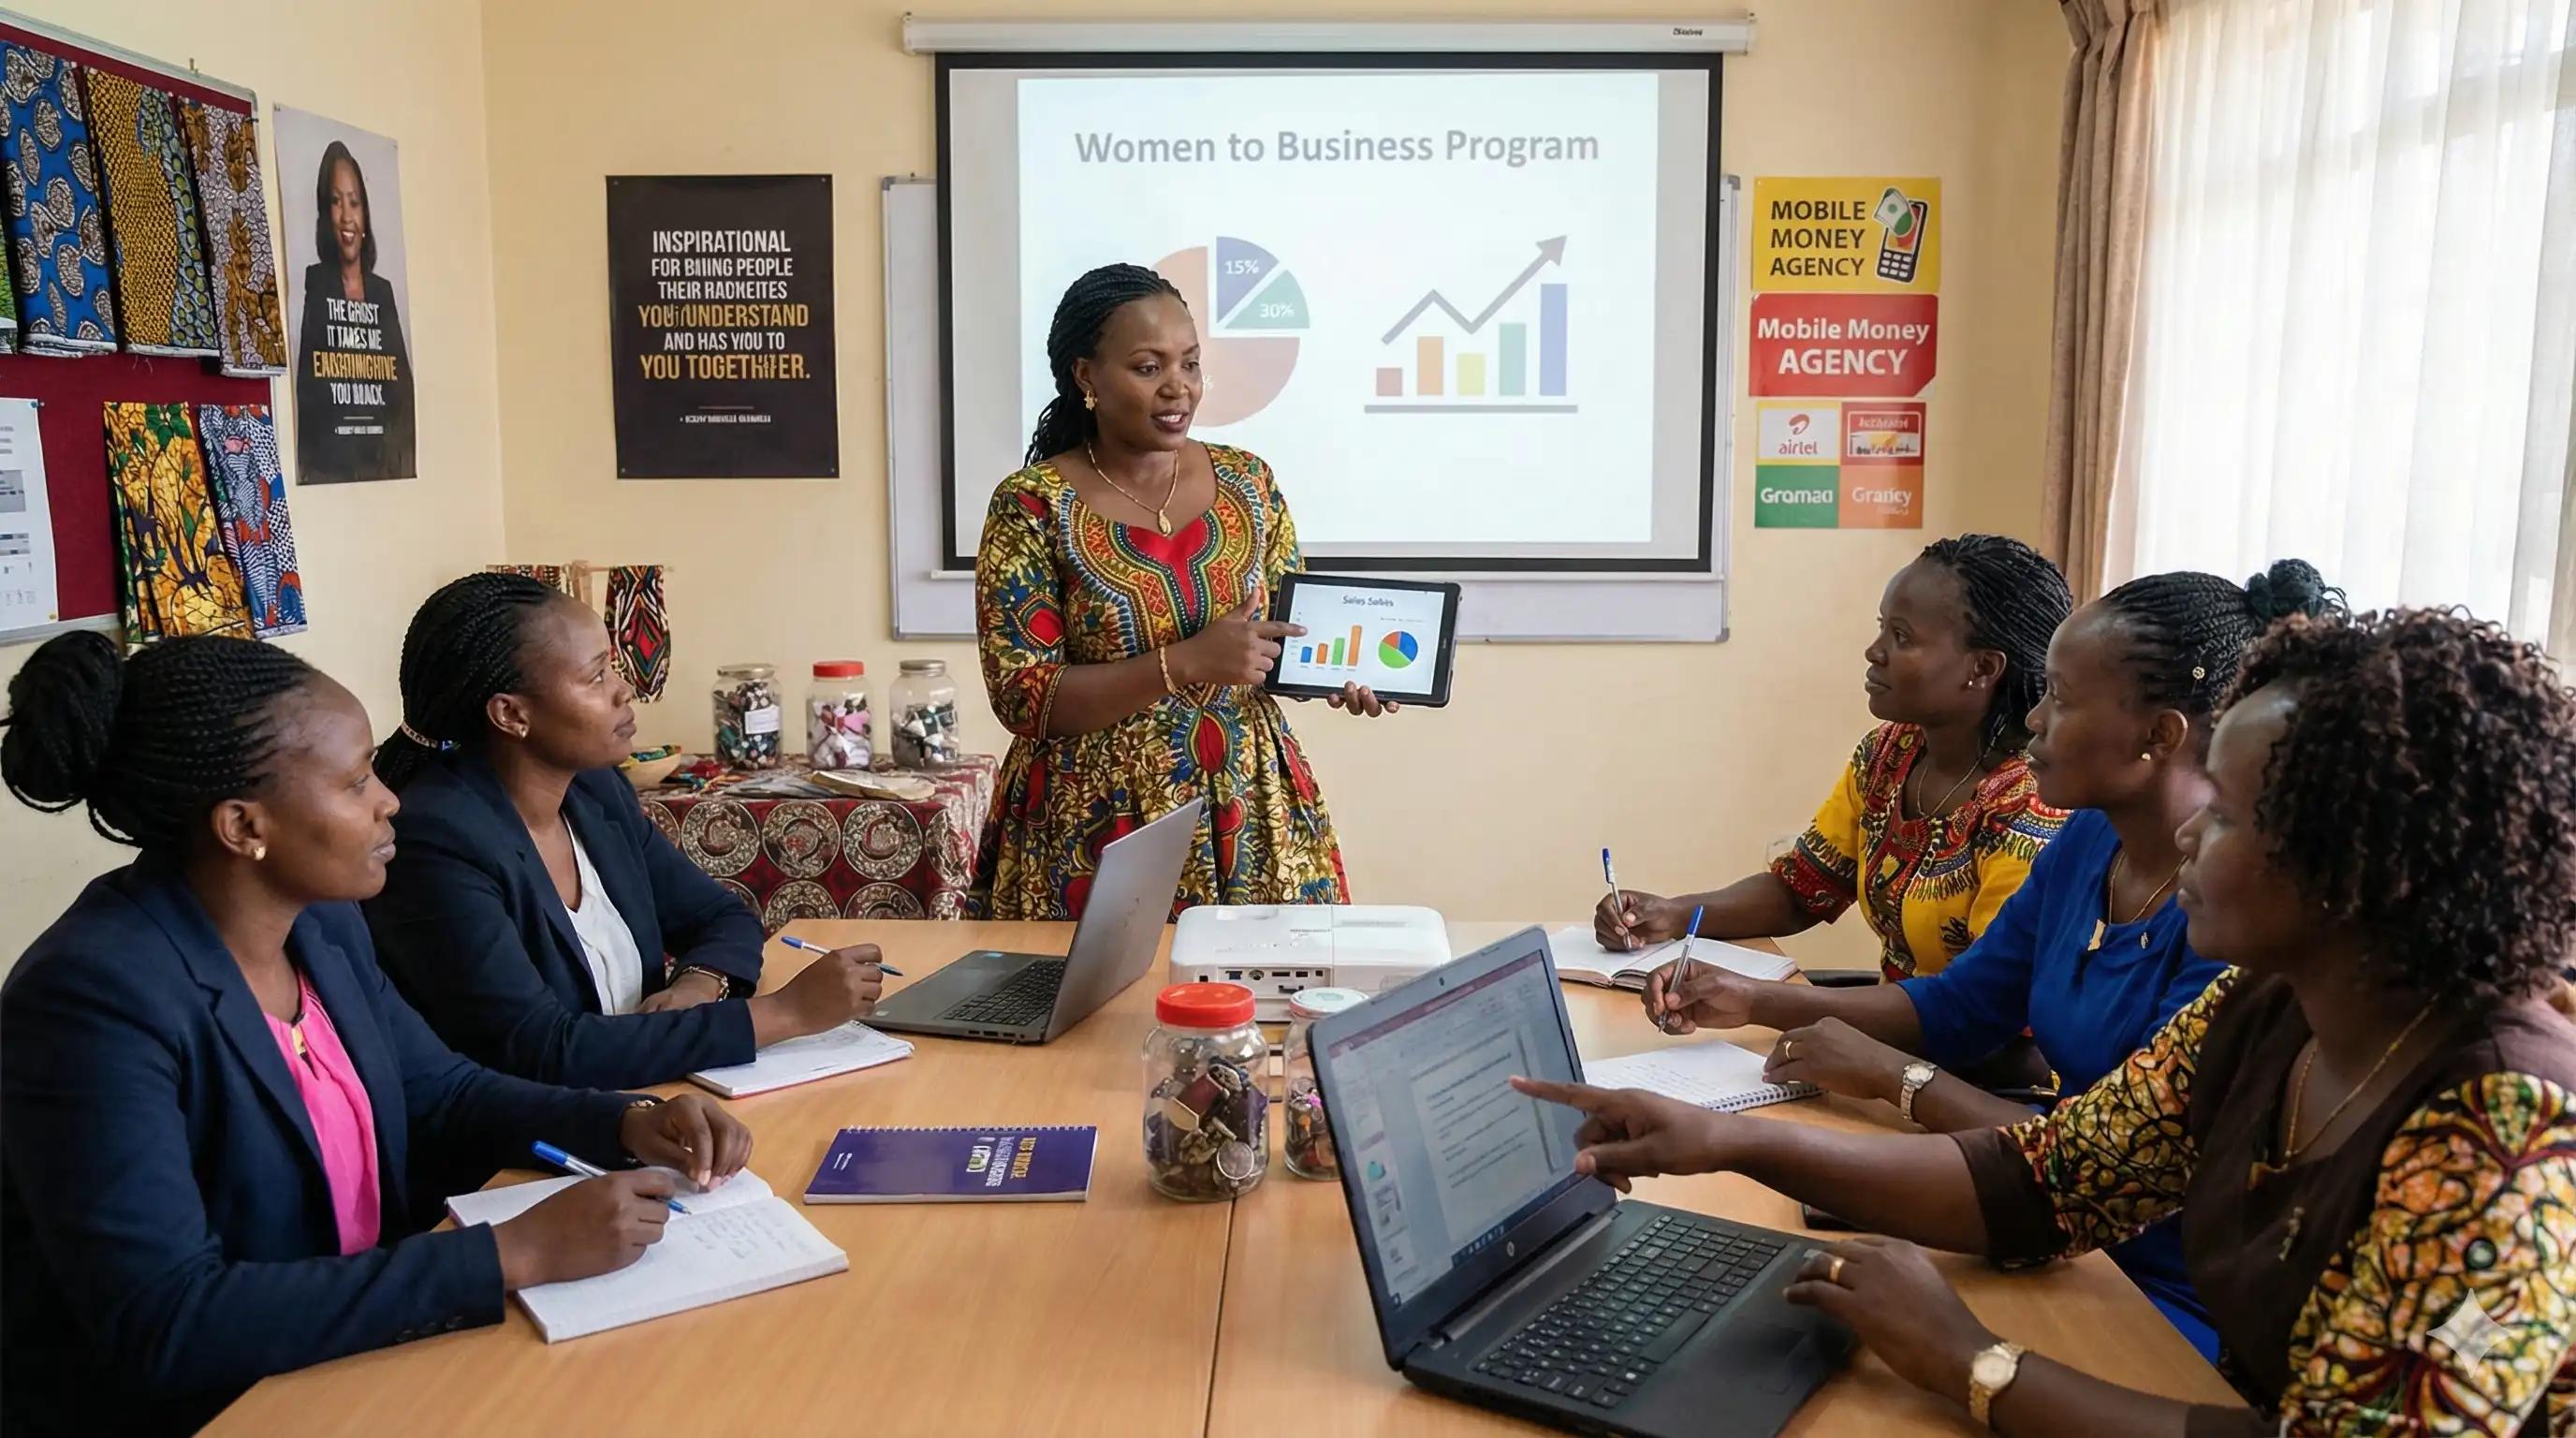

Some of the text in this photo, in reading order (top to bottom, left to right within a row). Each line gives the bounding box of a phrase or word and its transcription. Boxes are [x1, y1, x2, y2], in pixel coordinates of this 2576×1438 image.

[1074, 129, 1600, 168] Women to Business Program
[1771, 200, 1866, 220] MOBILE
[652, 230, 791, 253] INSPIRATIONAL
[1770, 228, 1865, 249] MONEY
[651, 257, 681, 276] FOR
[737, 257, 794, 276] PEOPLE
[1225, 259, 1260, 274] 15%
[1770, 257, 1865, 276] AGENCY
[657, 282, 701, 300] THEIR
[327, 298, 347, 322] THE
[1260, 303, 1295, 318] 30%
[664, 332, 695, 350] AND
[698, 332, 727, 350] HAS
[767, 331, 785, 350] TO
[1758, 318, 1930, 345] Mobile Money
[640, 354, 681, 379] YOU
[1778, 348, 1908, 374] AGENCY
[330, 383, 350, 404] YOU
